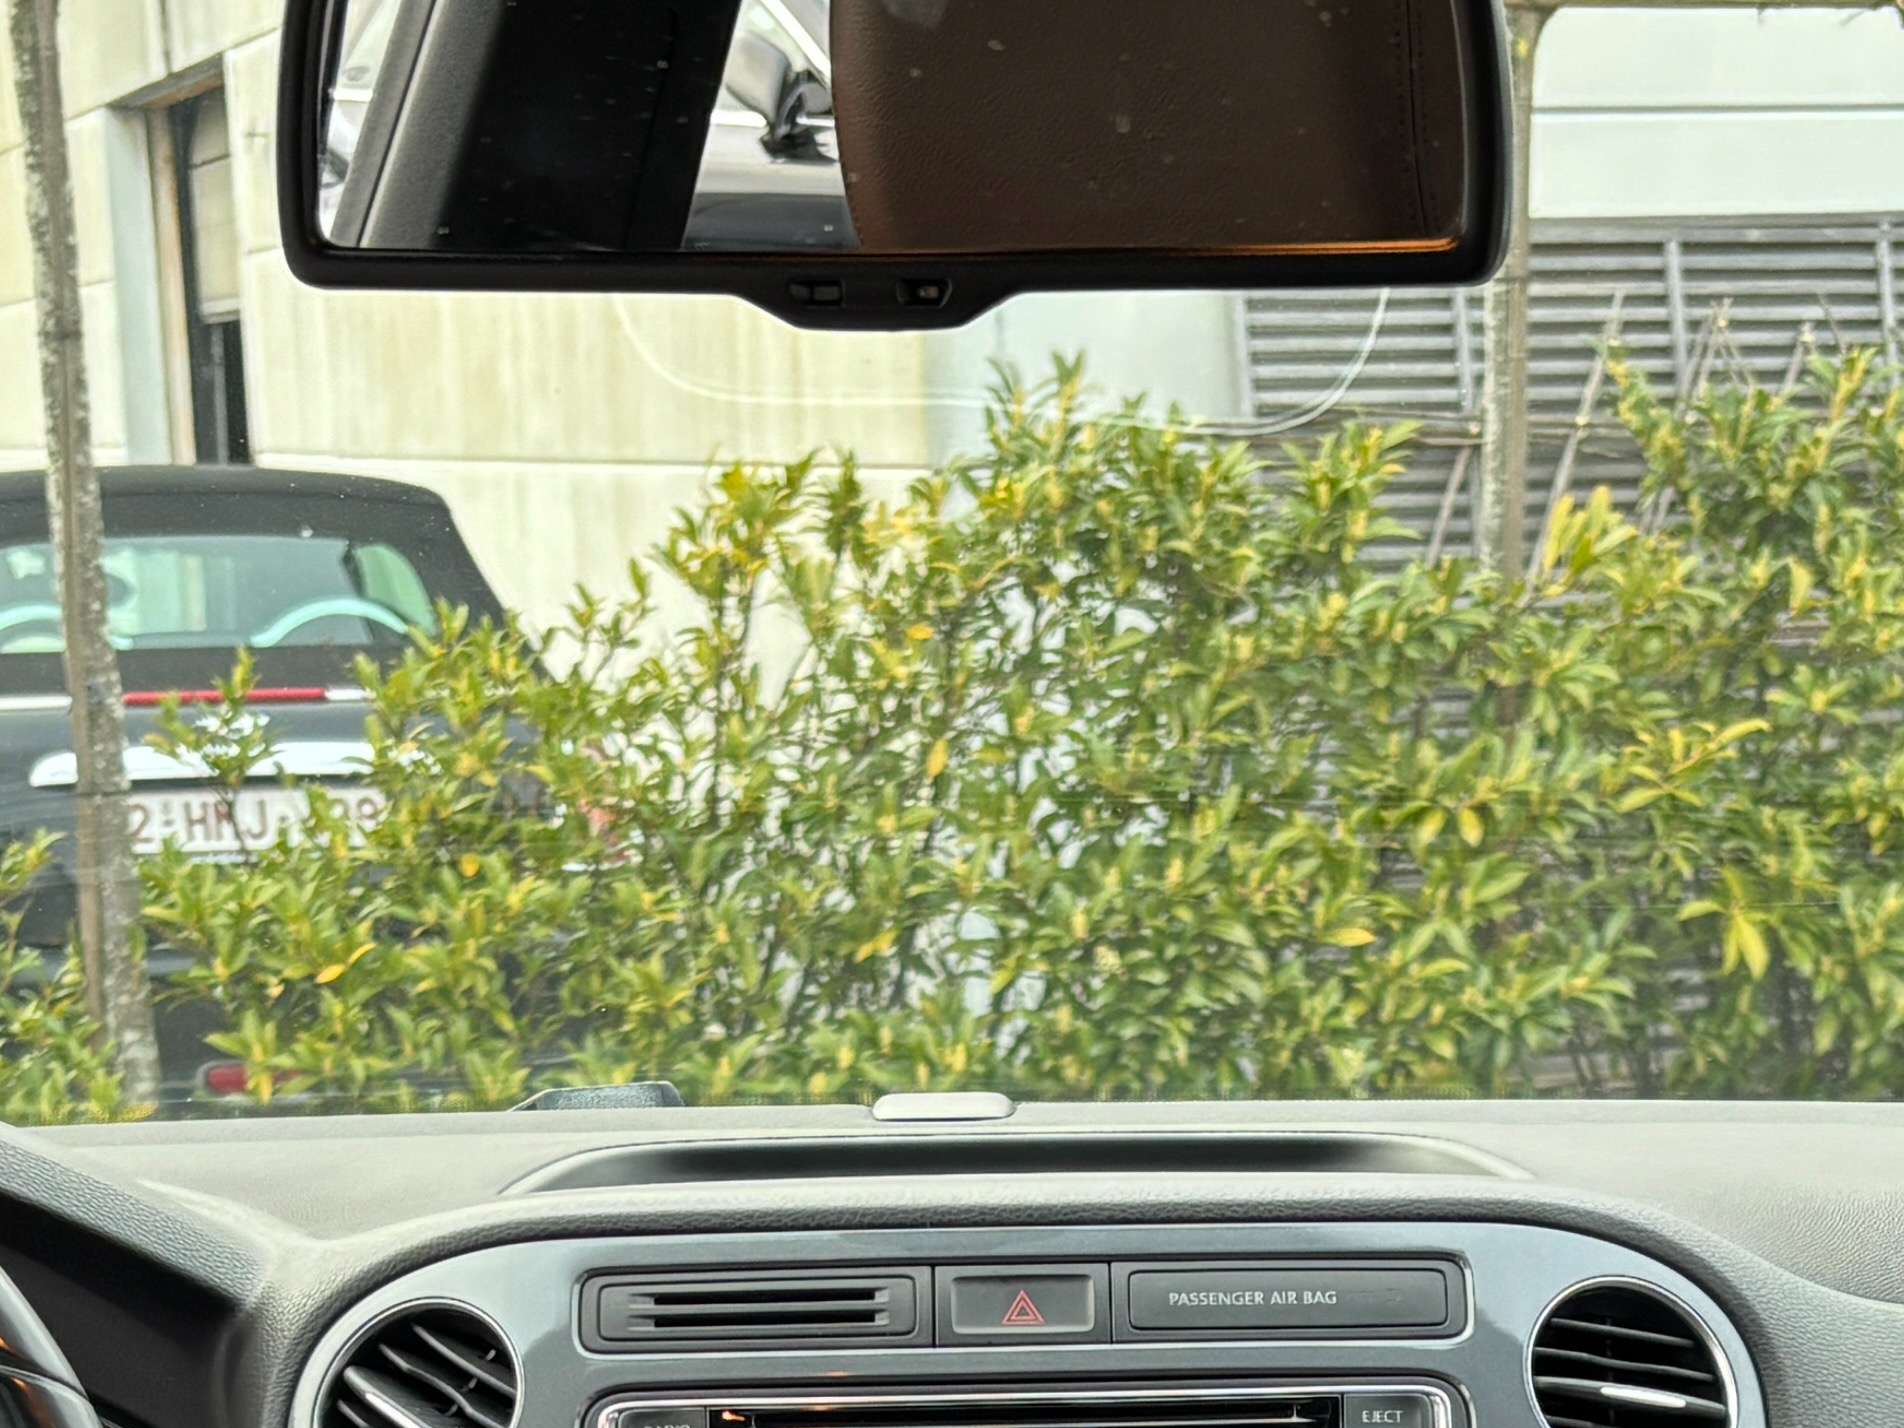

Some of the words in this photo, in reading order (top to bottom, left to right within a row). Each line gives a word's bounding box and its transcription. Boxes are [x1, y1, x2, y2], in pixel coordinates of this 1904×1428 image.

[1168, 1291, 1264, 1306] PASSENGER
[1270, 1291, 1298, 1305] AIR
[1303, 1290, 1337, 1305] BAG
[1361, 1410, 1404, 1423] EJECT
